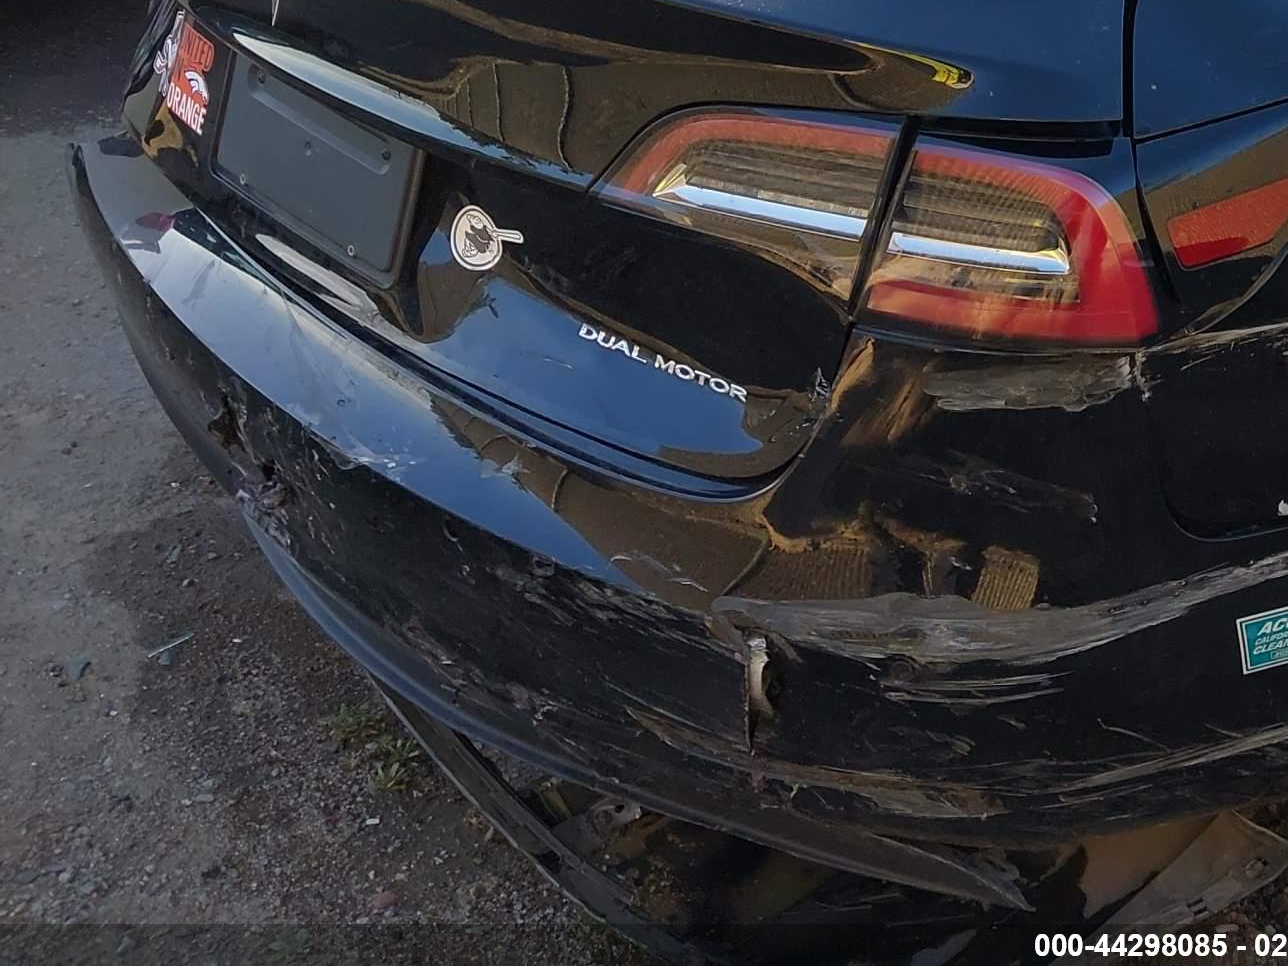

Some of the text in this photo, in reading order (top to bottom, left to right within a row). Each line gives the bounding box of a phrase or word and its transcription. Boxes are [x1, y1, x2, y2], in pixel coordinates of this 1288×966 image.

[166, 81, 207, 136] ORANGE
[578, 322, 748, 403] DUAL MOTOR
